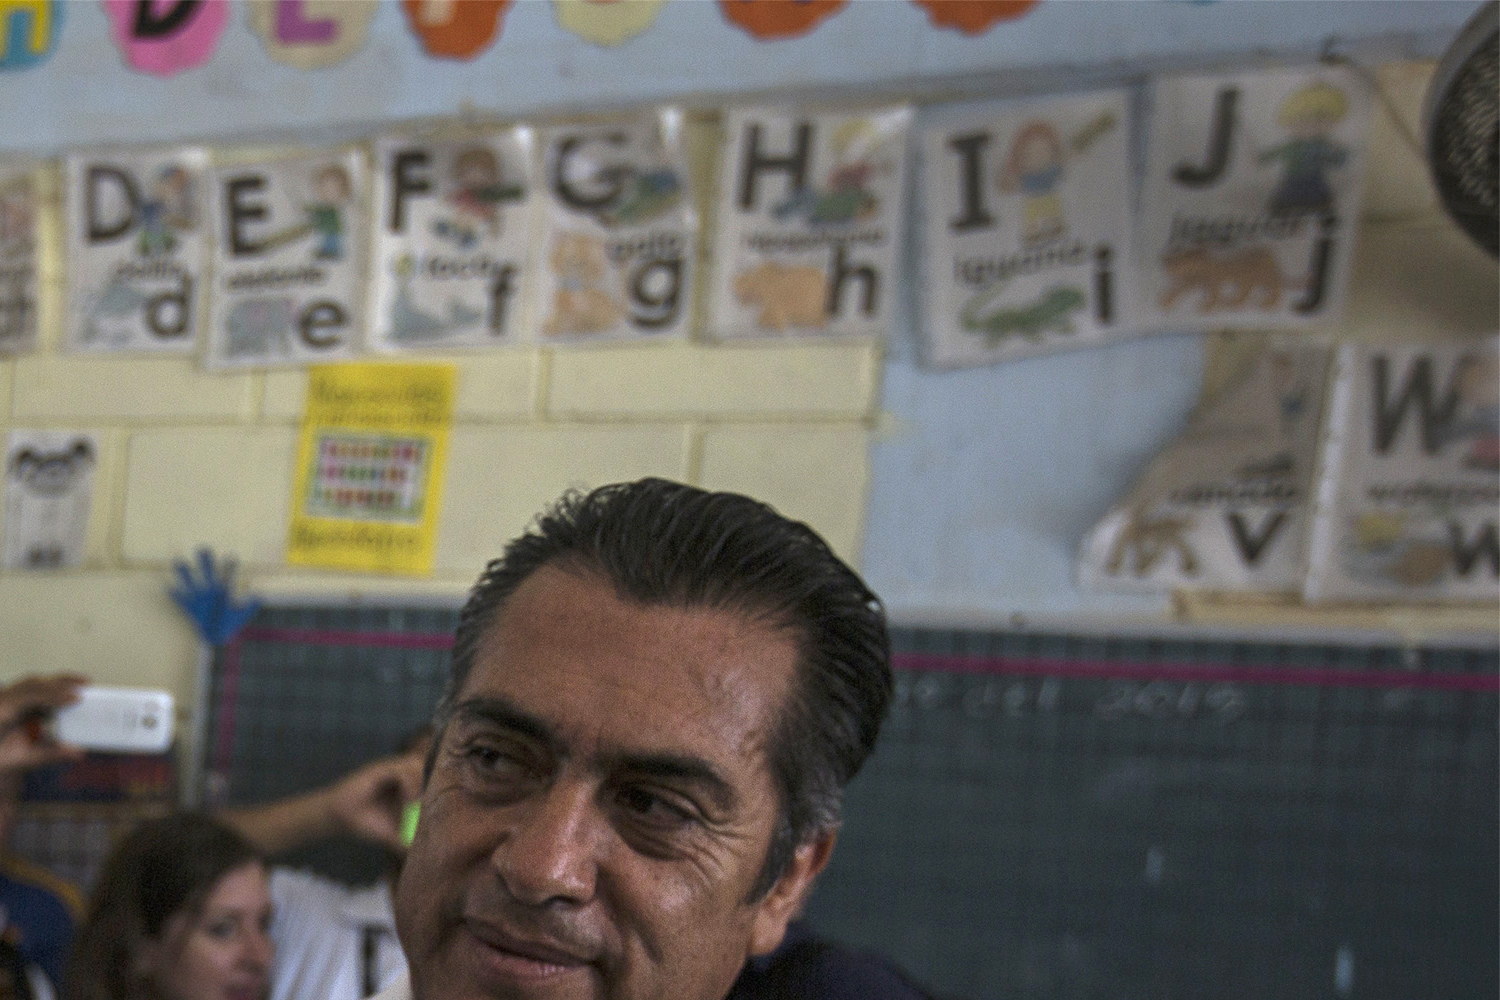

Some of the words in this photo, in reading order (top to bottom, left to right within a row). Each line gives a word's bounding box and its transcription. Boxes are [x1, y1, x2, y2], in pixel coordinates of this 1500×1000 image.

[552, 133, 630, 214] G
[737, 120, 814, 212] H
[1172, 85, 1241, 190] J
[84, 164, 142, 245] D
[226, 177, 270, 258] E
[389, 150, 431, 233] F
[944, 130, 997, 233] I
[145, 267, 191, 339] d
[486, 264, 520, 336] f
[626, 258, 684, 329] g
[825, 246, 878, 317] h
[1094, 245, 1114, 324] i
[1290, 211, 1337, 314] j
[298, 300, 348, 349] e
[1369, 354, 1473, 457] W
